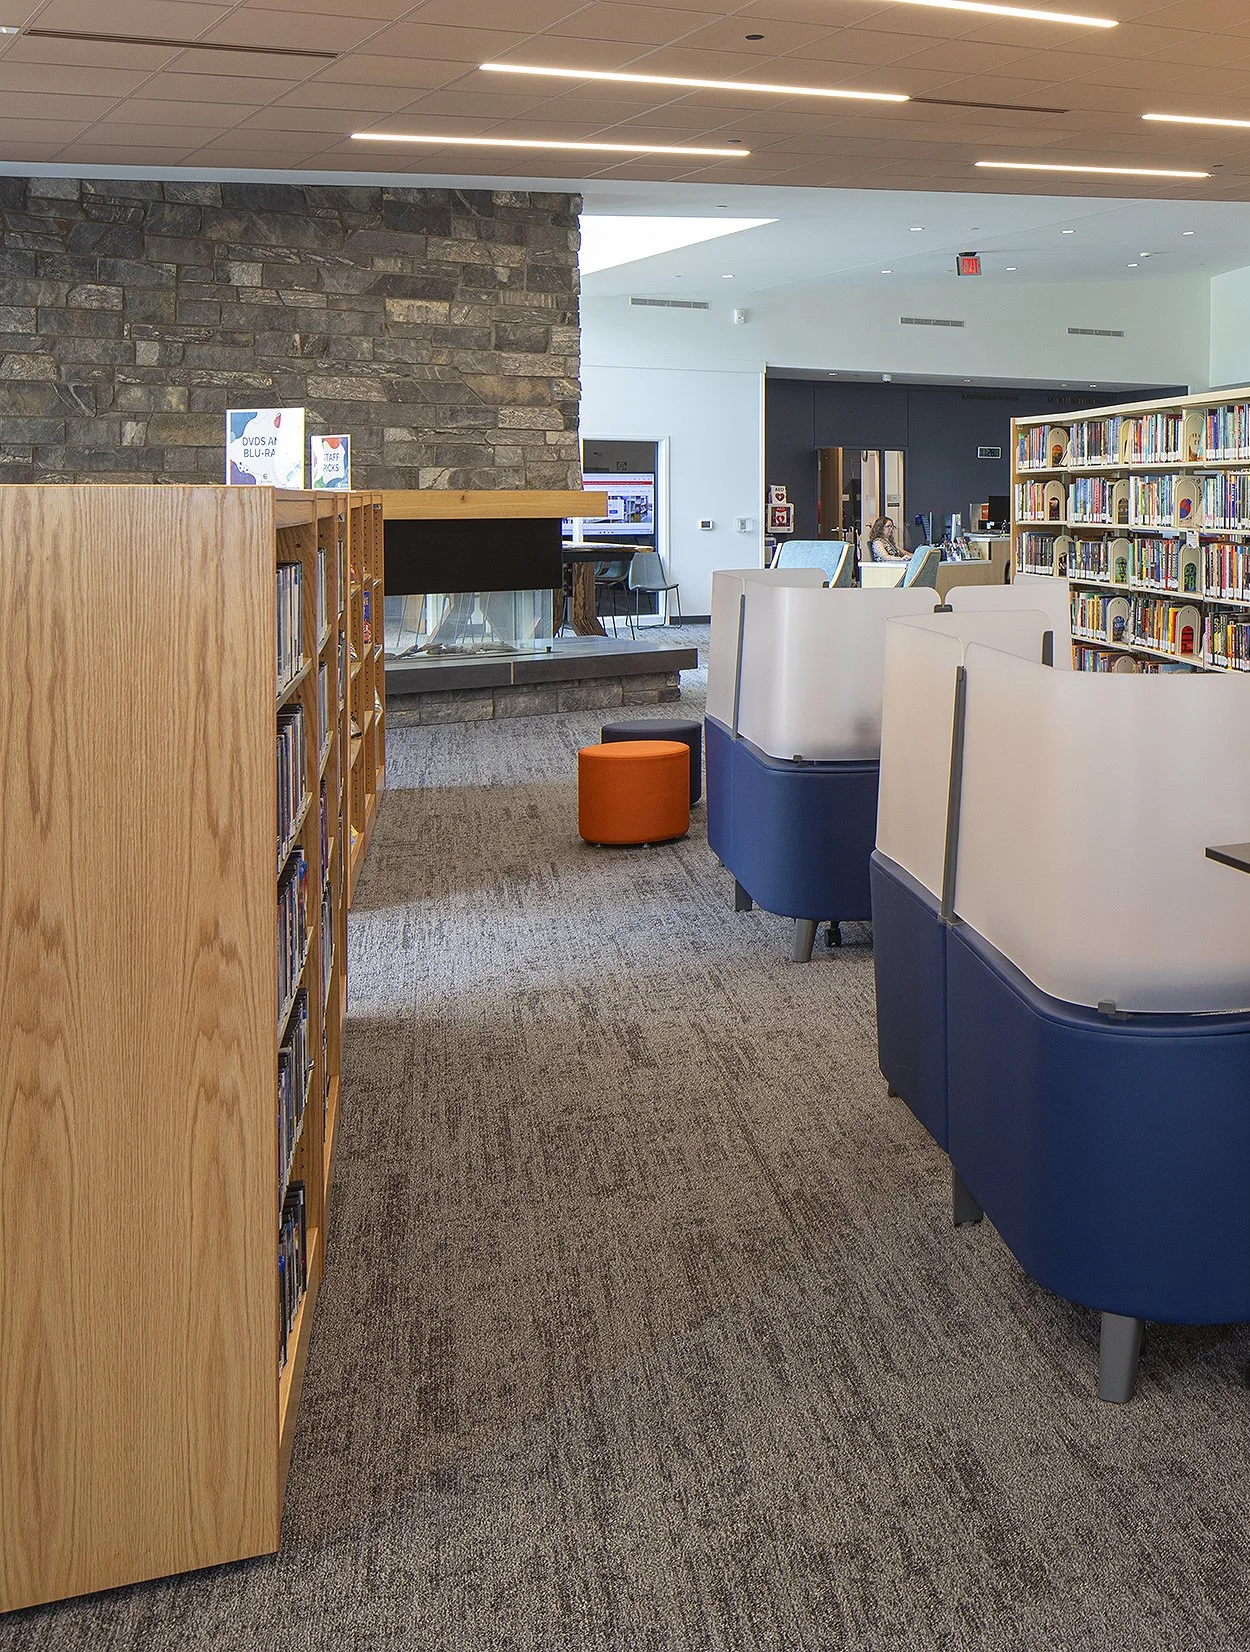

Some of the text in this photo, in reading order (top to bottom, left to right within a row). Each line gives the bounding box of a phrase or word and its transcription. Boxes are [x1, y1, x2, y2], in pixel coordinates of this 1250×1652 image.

[242, 436, 266, 447] DVDS
[243, 448, 276, 458] BLU-RA
[323, 453, 340, 462] TAFF
